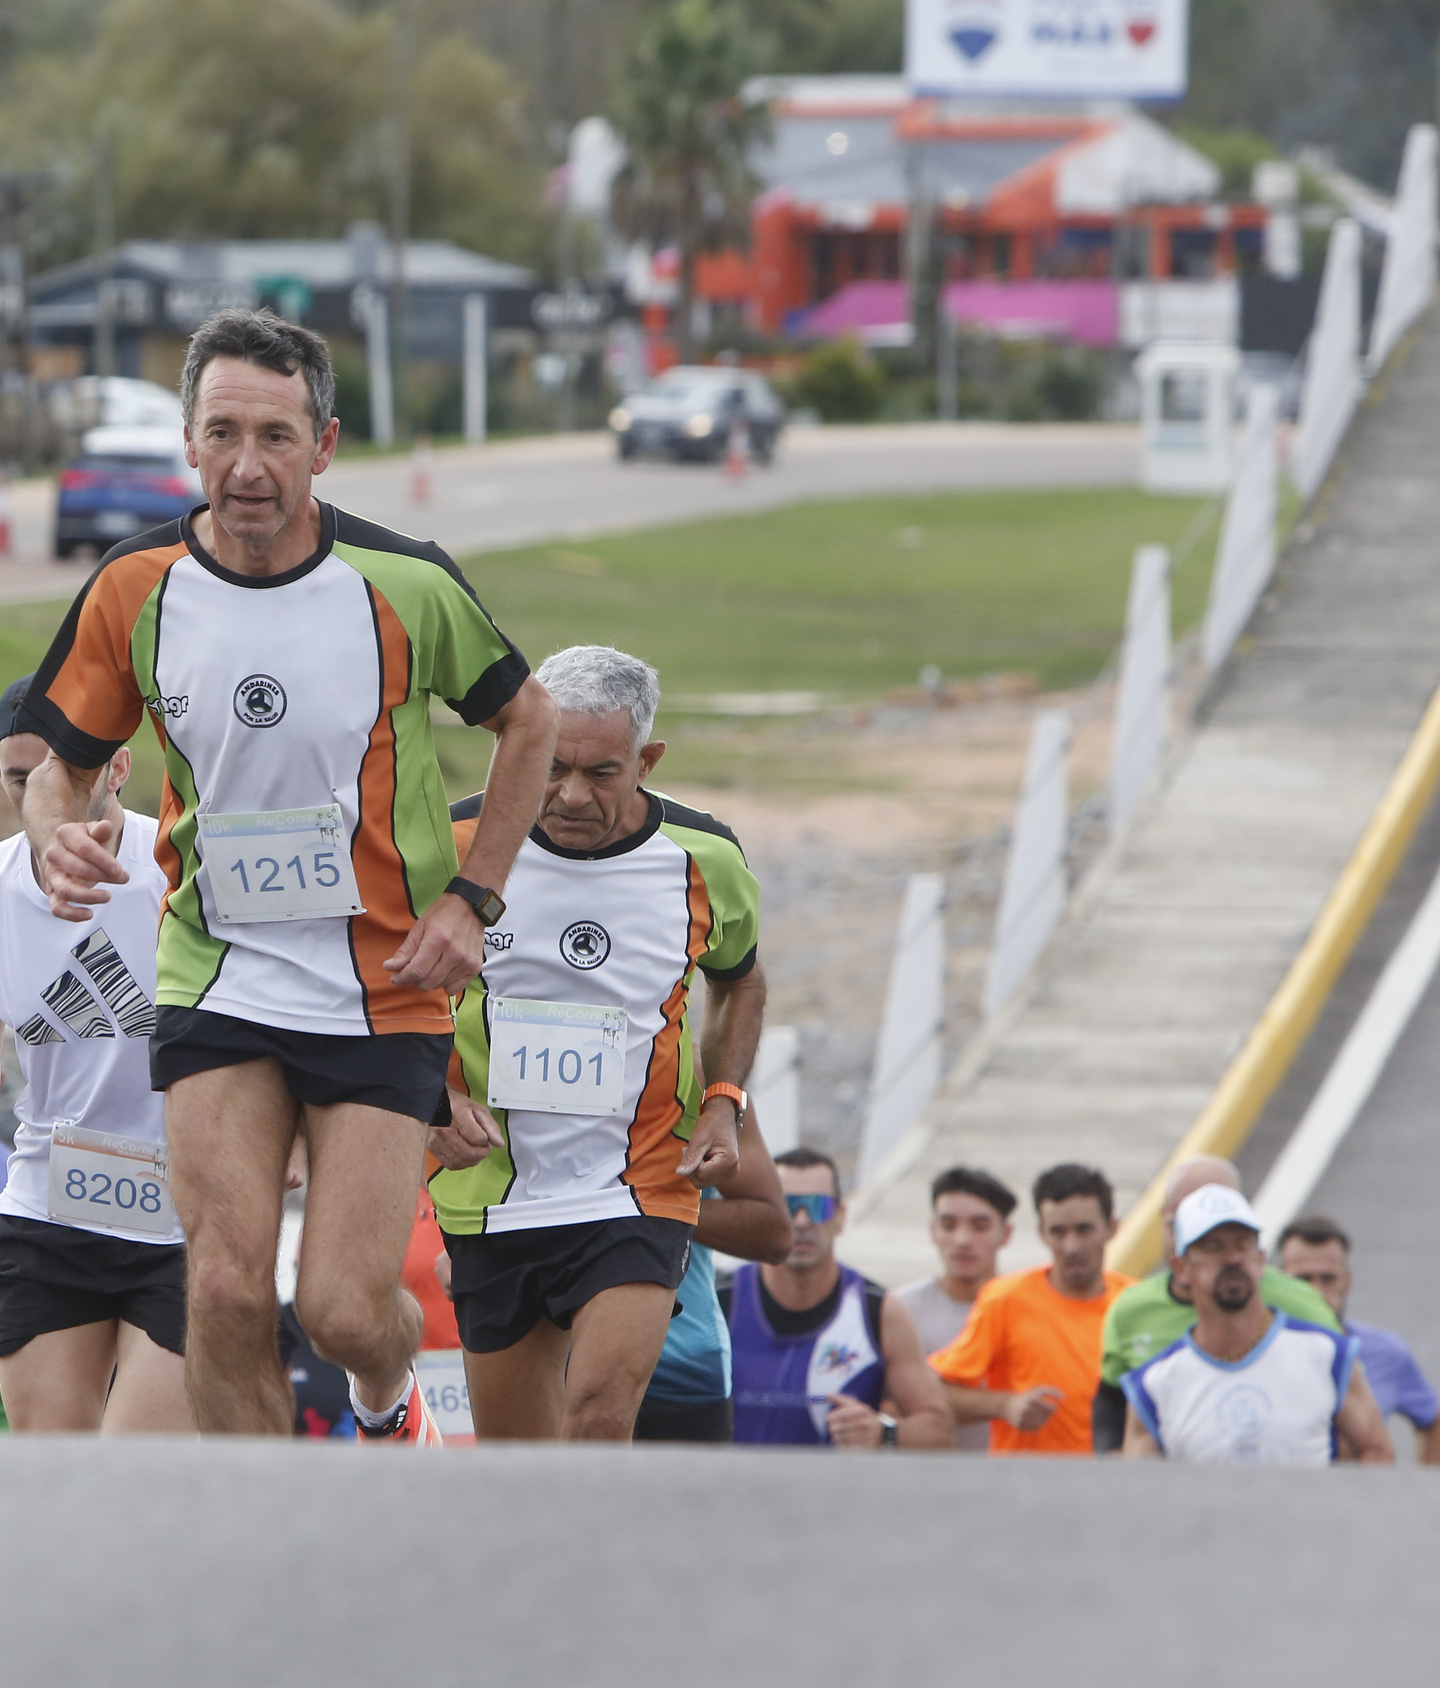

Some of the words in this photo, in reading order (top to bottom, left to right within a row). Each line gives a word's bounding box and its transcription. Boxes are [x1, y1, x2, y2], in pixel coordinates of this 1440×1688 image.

[240, 681, 280, 697] ANDARINES
[230, 852, 341, 893] 1215
[568, 926, 605, 941] ANDARINES
[512, 1045, 603, 1086] 1101
[58, 1129, 75, 1145] 5k
[65, 1168, 161, 1213] 8208
